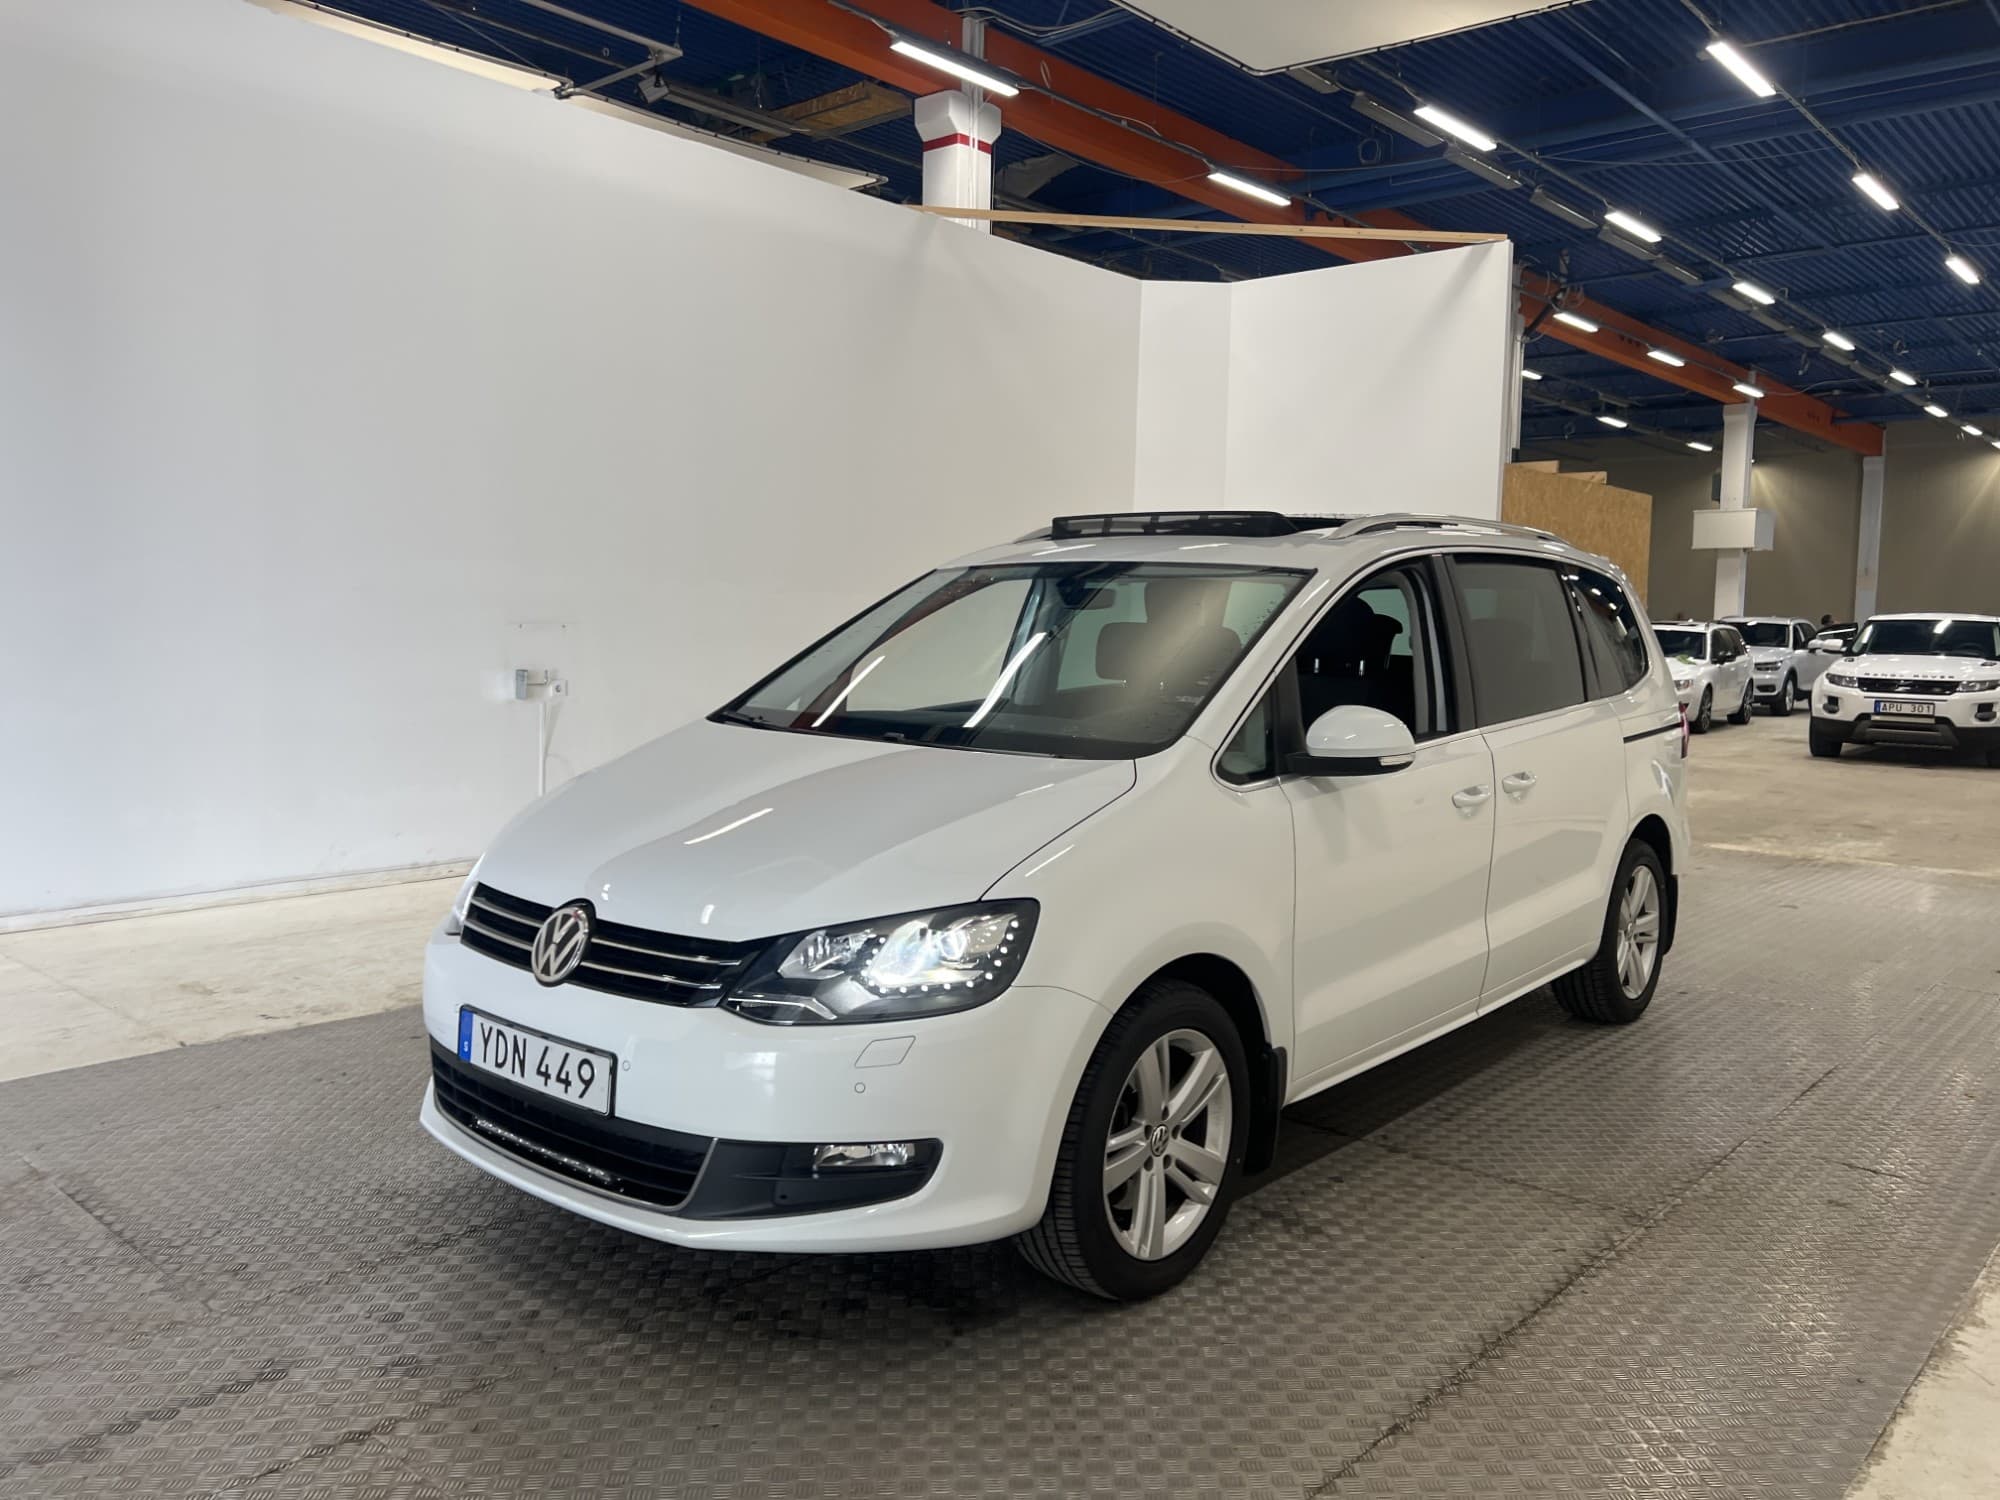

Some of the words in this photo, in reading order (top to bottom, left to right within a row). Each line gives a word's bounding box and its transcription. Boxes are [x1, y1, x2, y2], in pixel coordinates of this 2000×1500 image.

[1881, 703, 1903, 713] APU
[1911, 704, 1931, 713] 301
[480, 1022, 527, 1078] YDN
[536, 1046, 595, 1099] 449
